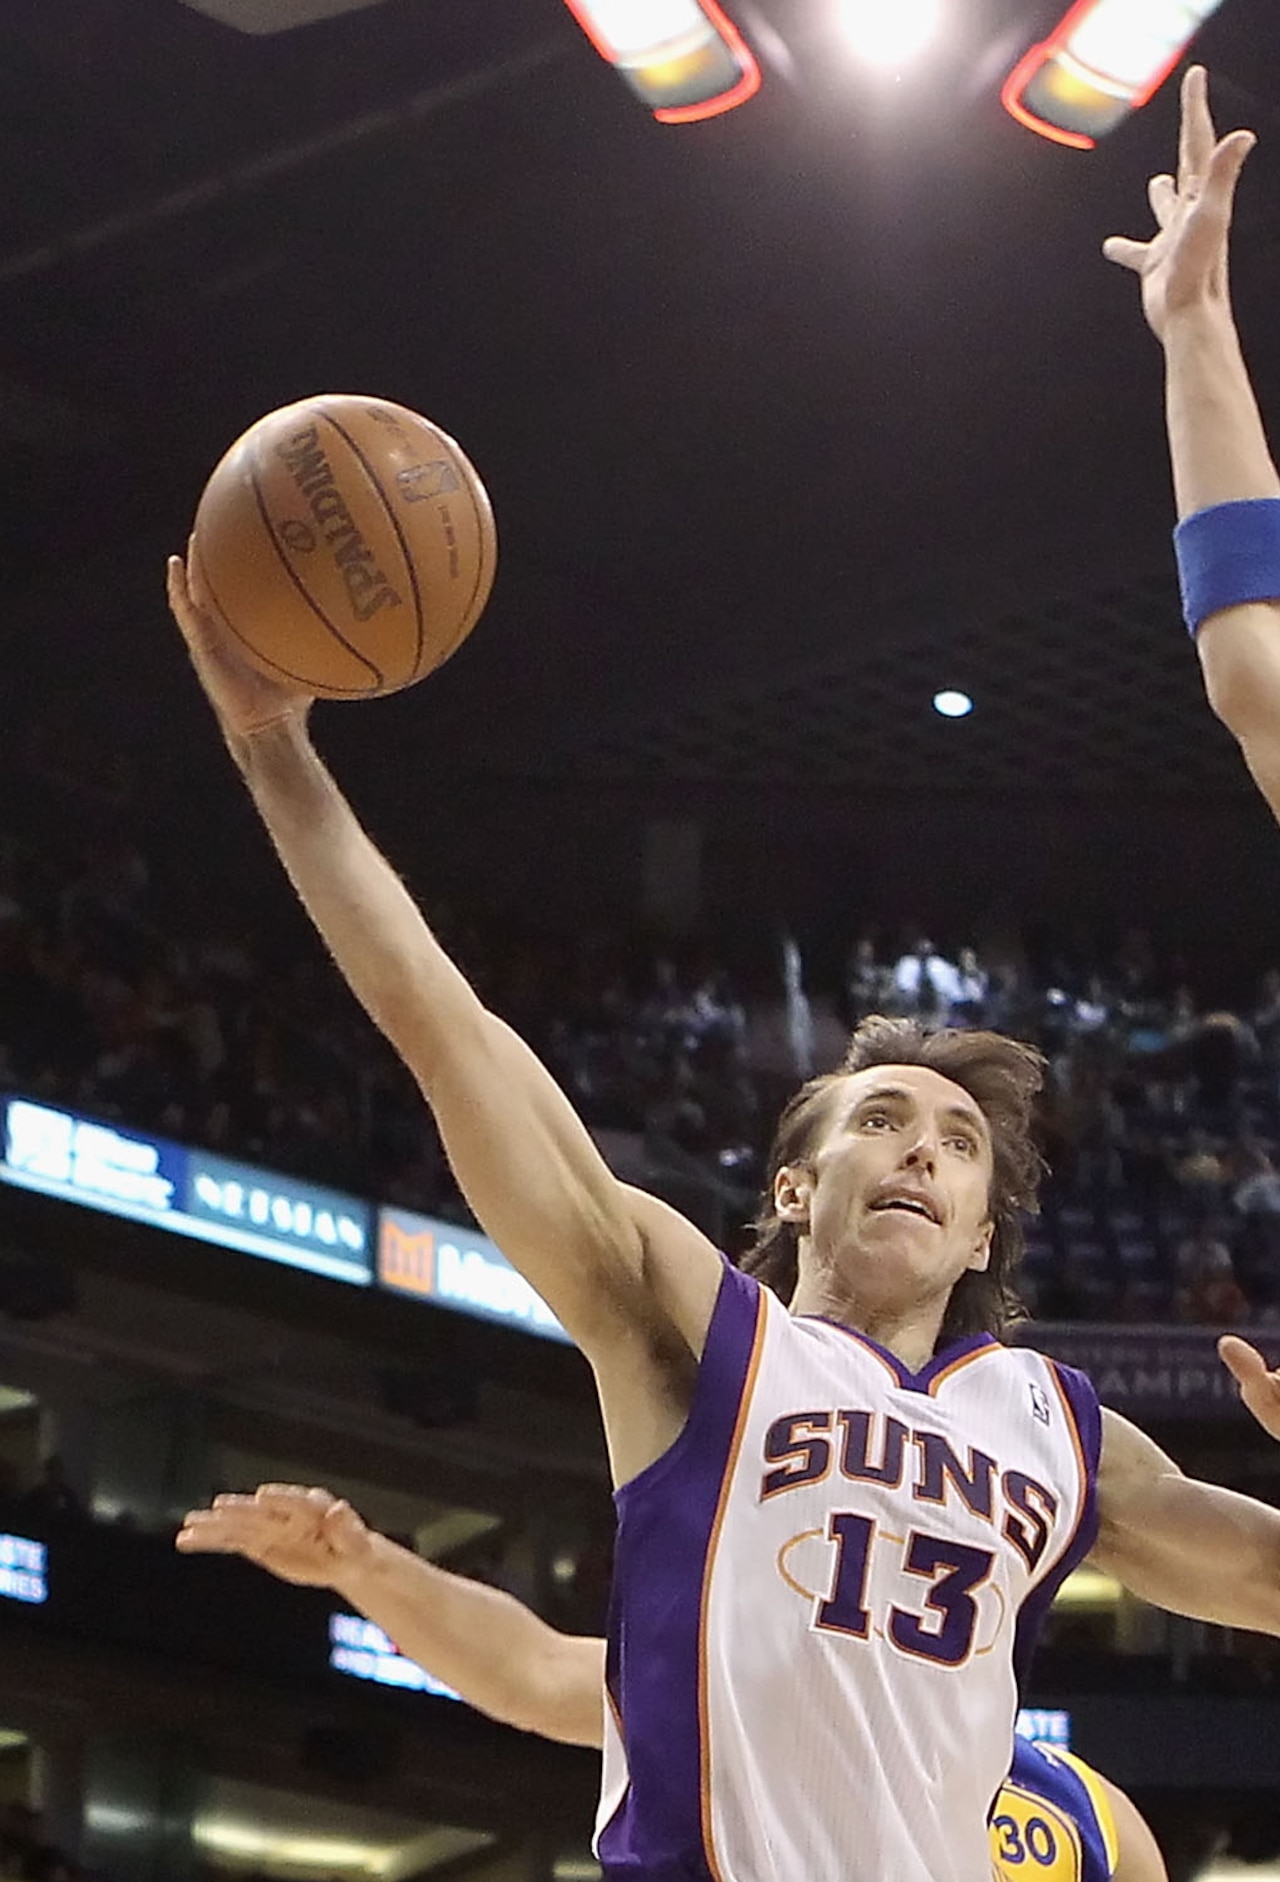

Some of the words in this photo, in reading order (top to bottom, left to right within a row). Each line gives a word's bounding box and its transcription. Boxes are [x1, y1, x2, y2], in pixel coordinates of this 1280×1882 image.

[759, 1409, 1057, 1576] SUNS
[809, 1510, 997, 1670] 13
[992, 1814, 1057, 1867] 30
